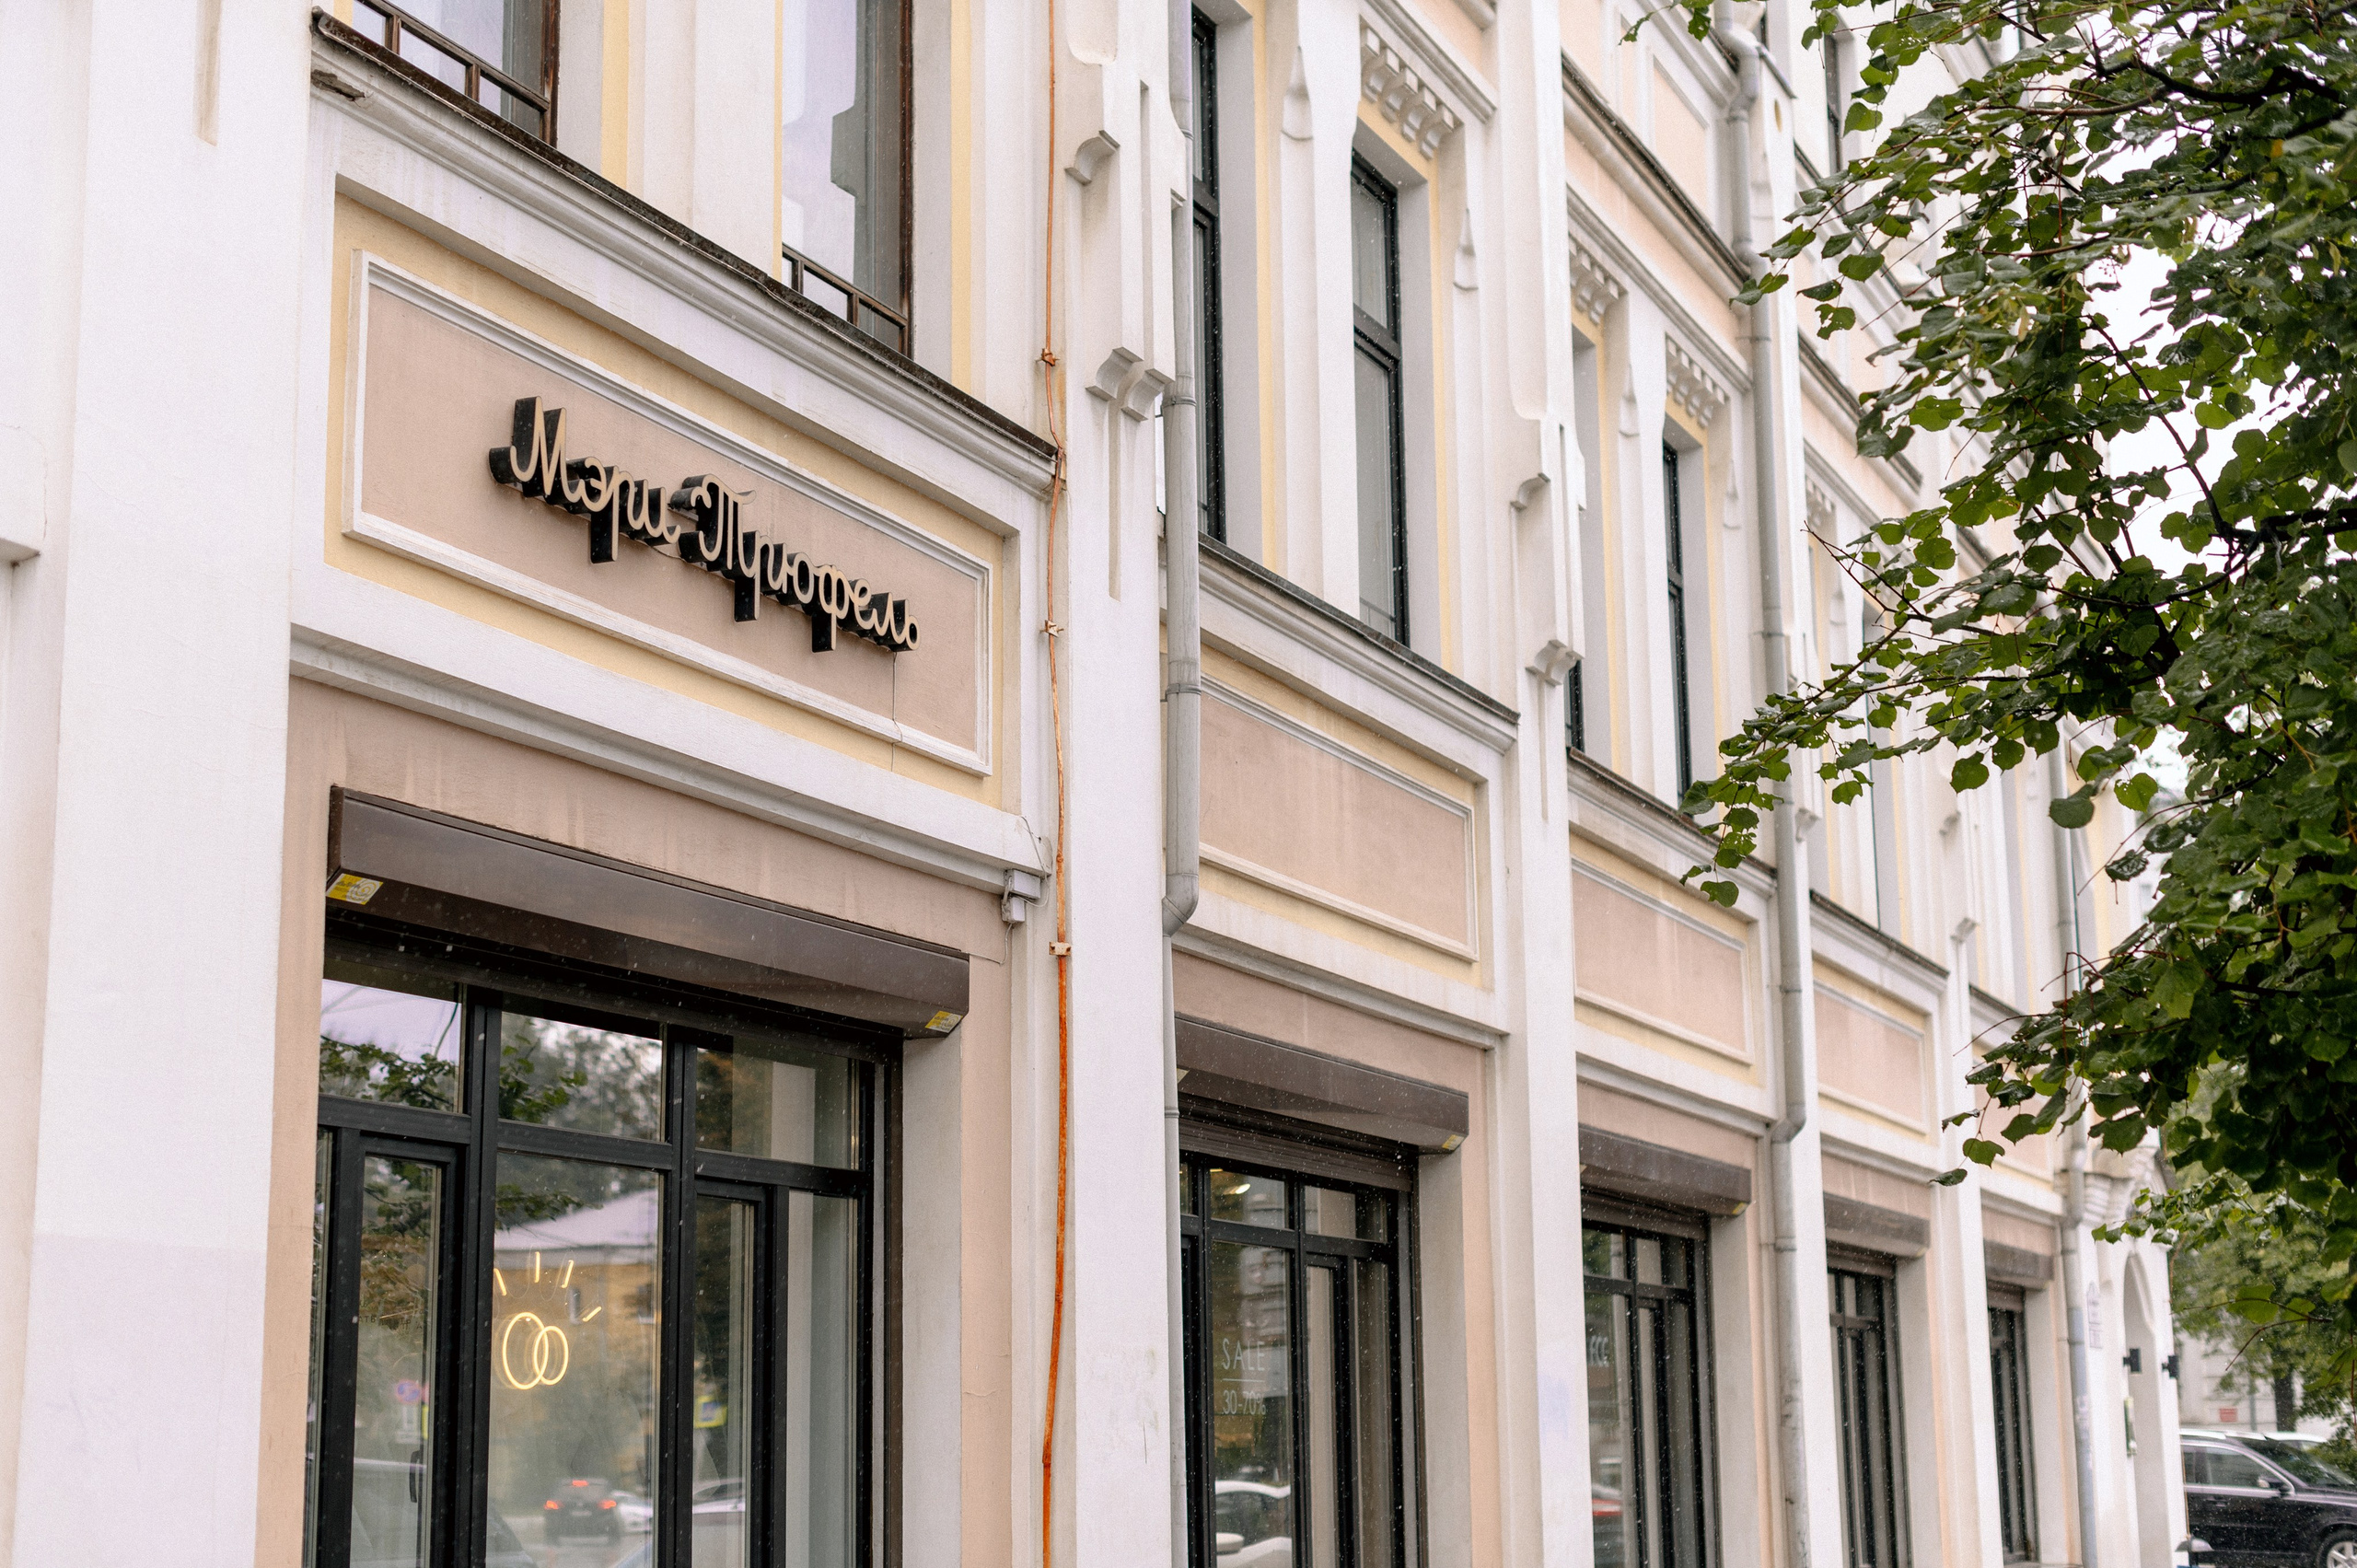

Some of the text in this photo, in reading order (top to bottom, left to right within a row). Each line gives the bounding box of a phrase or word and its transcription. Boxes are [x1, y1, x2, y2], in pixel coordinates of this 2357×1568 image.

[500, 395, 920, 652] Мэри Трюфель
[1221, 1338, 1266, 1372] SALE
[1222, 1389, 1267, 1415] 30-70%
